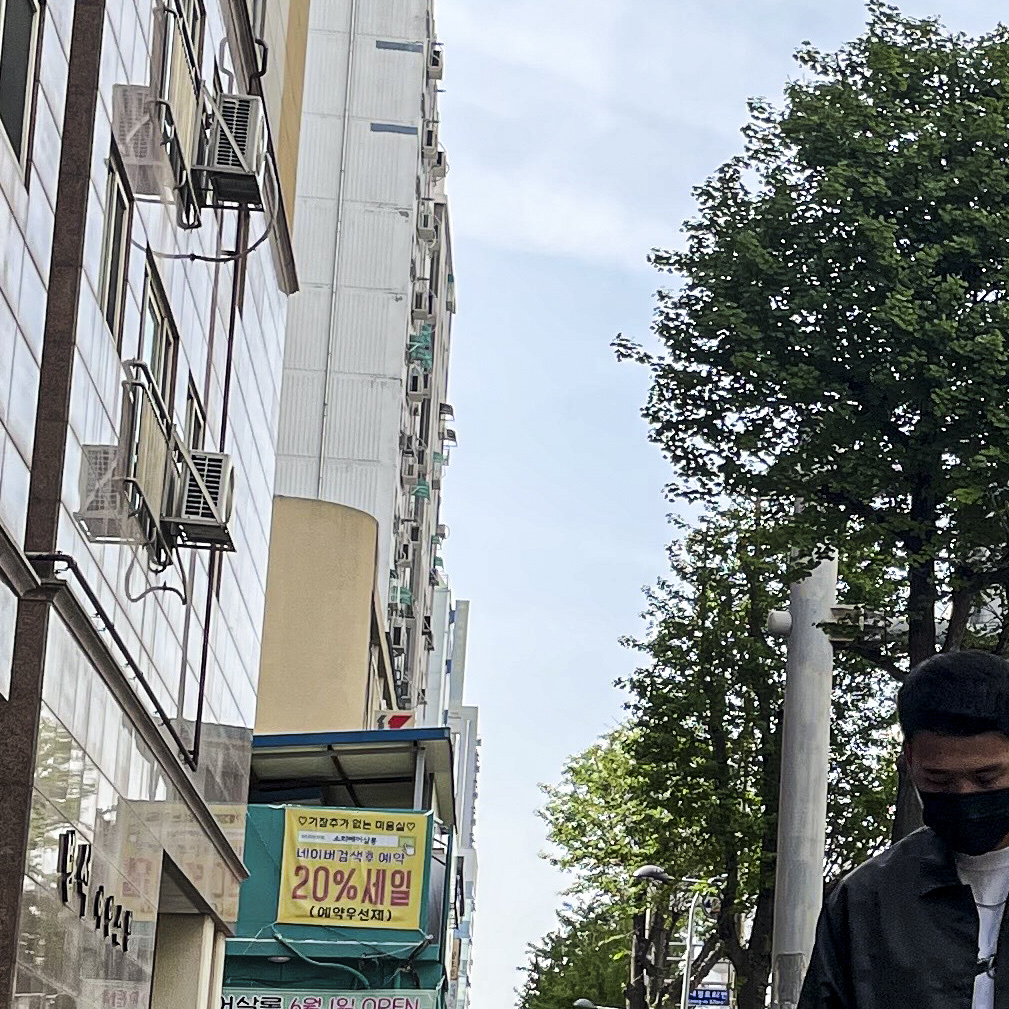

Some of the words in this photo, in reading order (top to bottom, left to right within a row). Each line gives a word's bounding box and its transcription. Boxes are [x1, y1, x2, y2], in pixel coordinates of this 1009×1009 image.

[375, 820, 406, 832] 미용실
[378, 852, 406, 865] 예약
[291, 865, 412, 907] 20%세일
